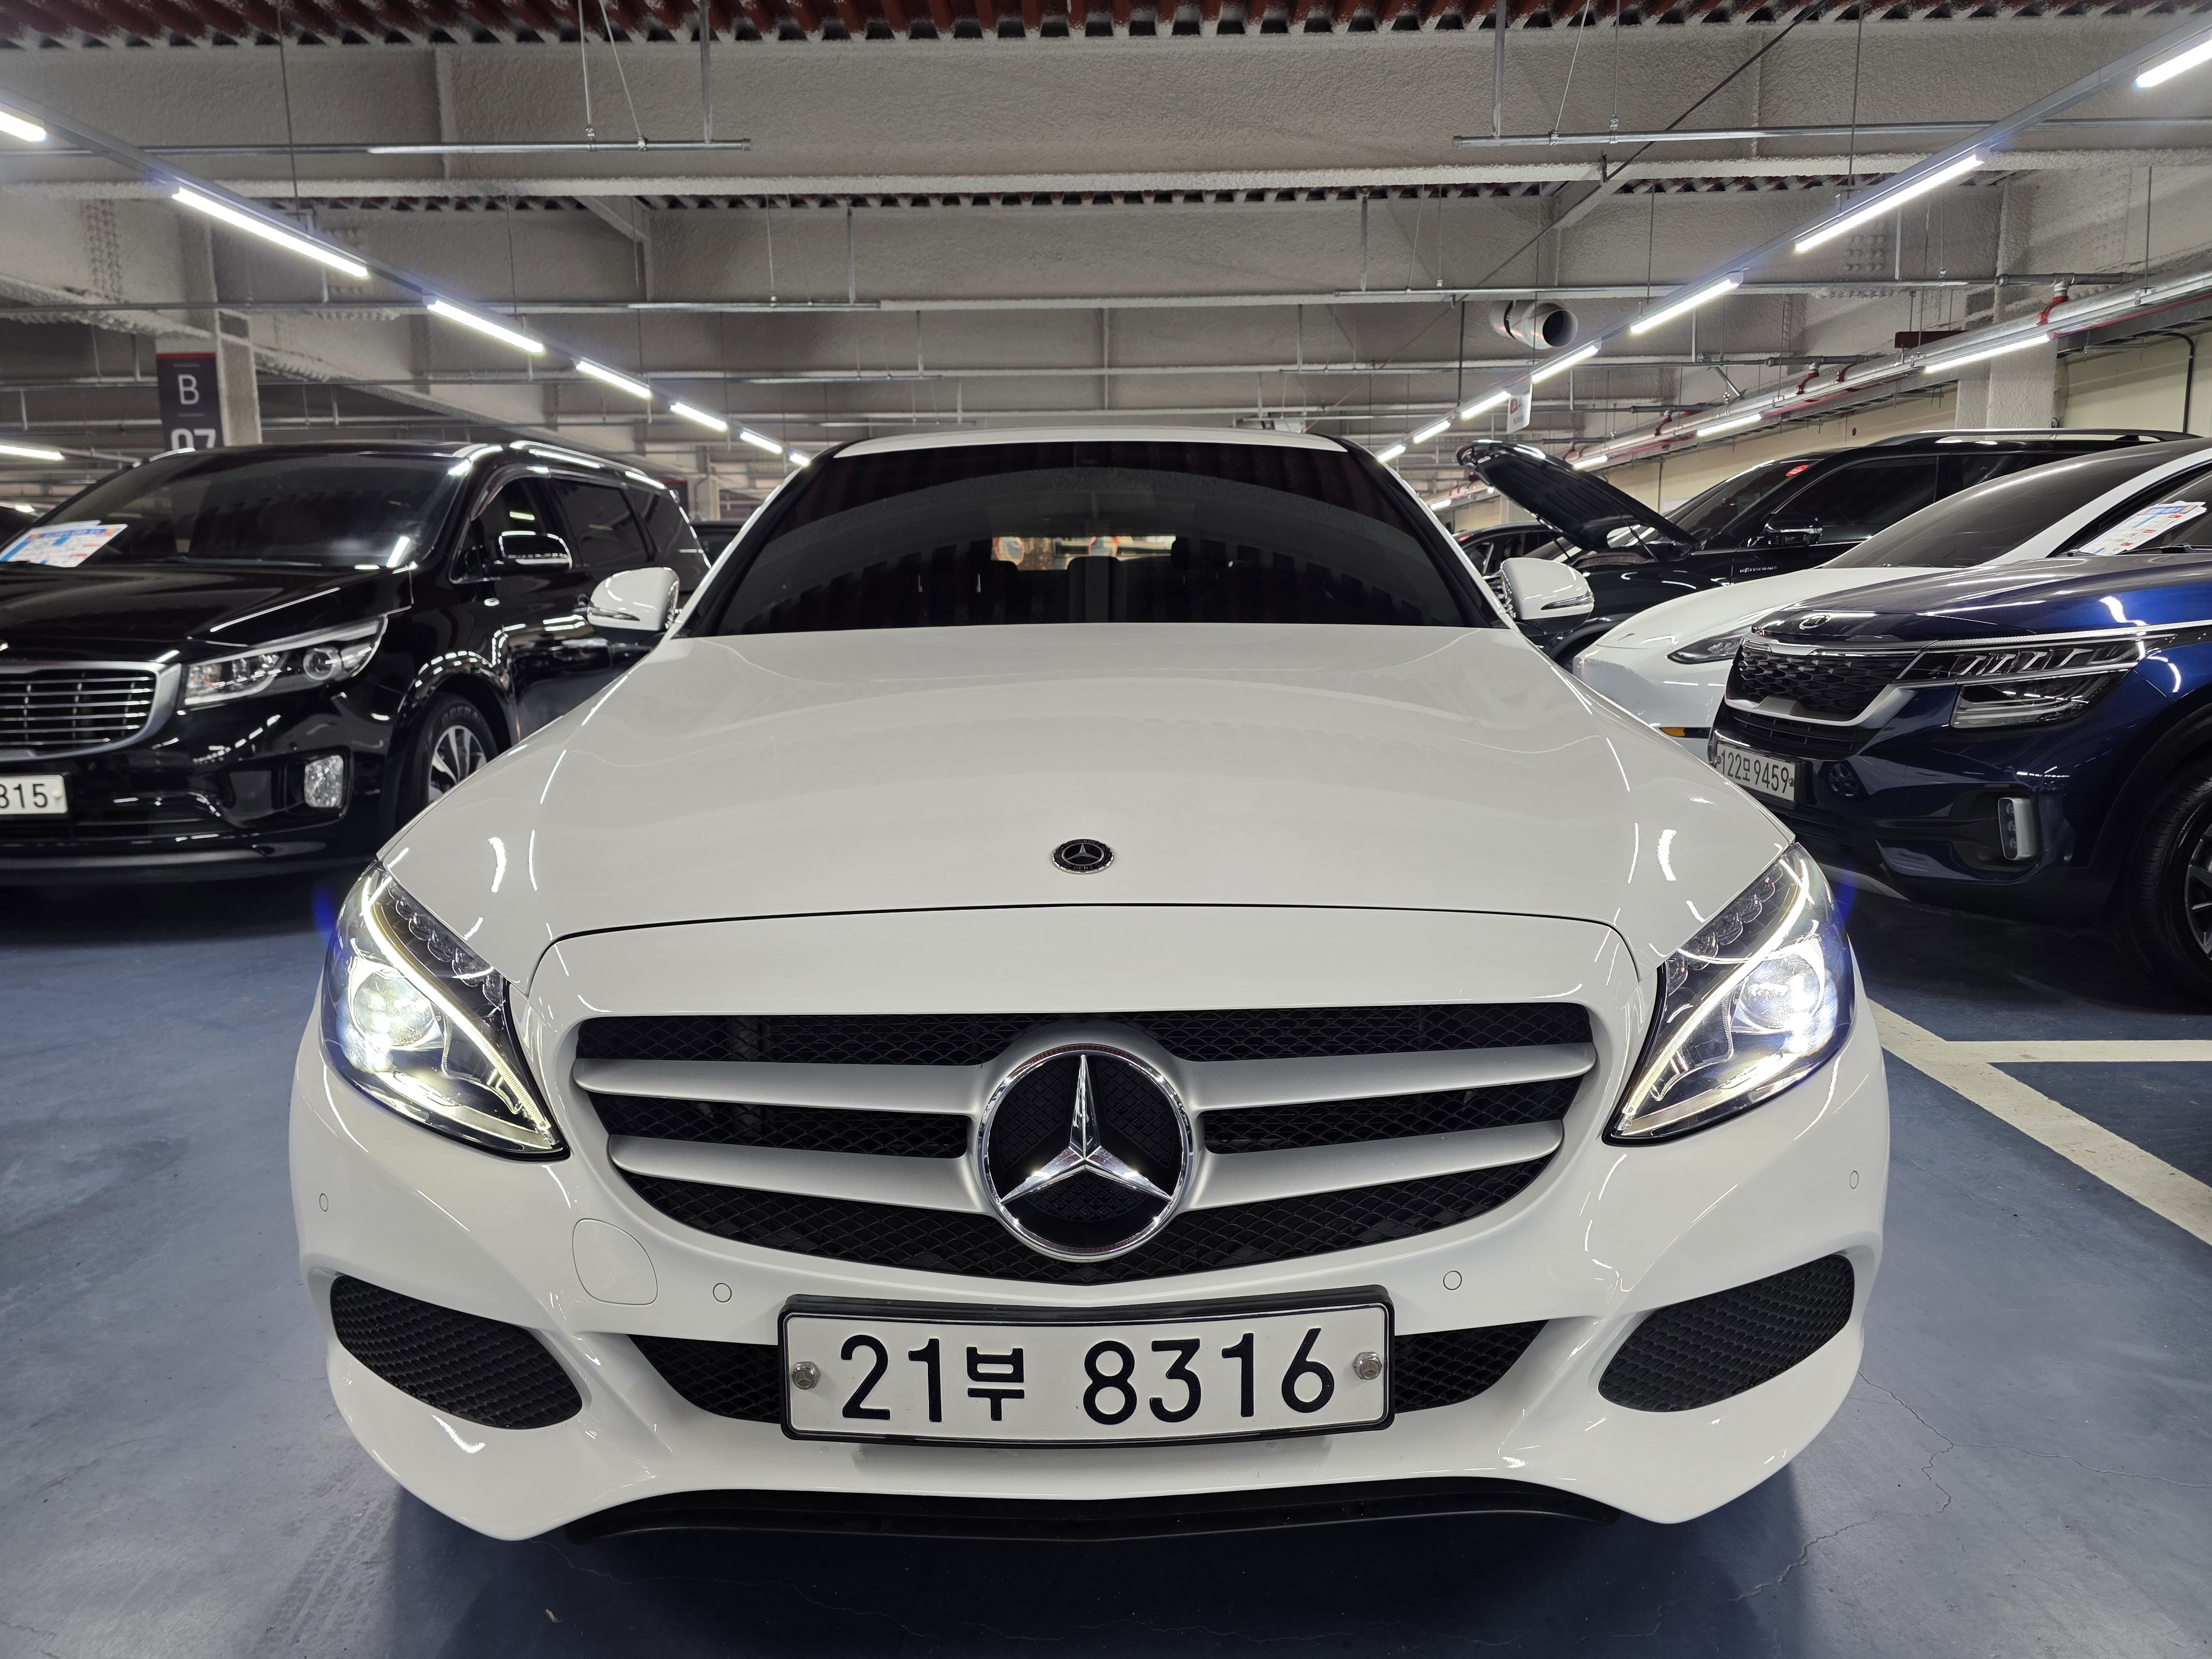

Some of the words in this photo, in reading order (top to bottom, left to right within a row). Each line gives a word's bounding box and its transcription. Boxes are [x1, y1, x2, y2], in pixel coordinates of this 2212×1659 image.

[178, 374, 200, 405] B
[1721, 749, 1751, 782] 122모
[1754, 759, 1790, 794] 9459
[840, 1334, 1025, 1423] 21부
[1082, 1327, 1335, 1426] 8316
